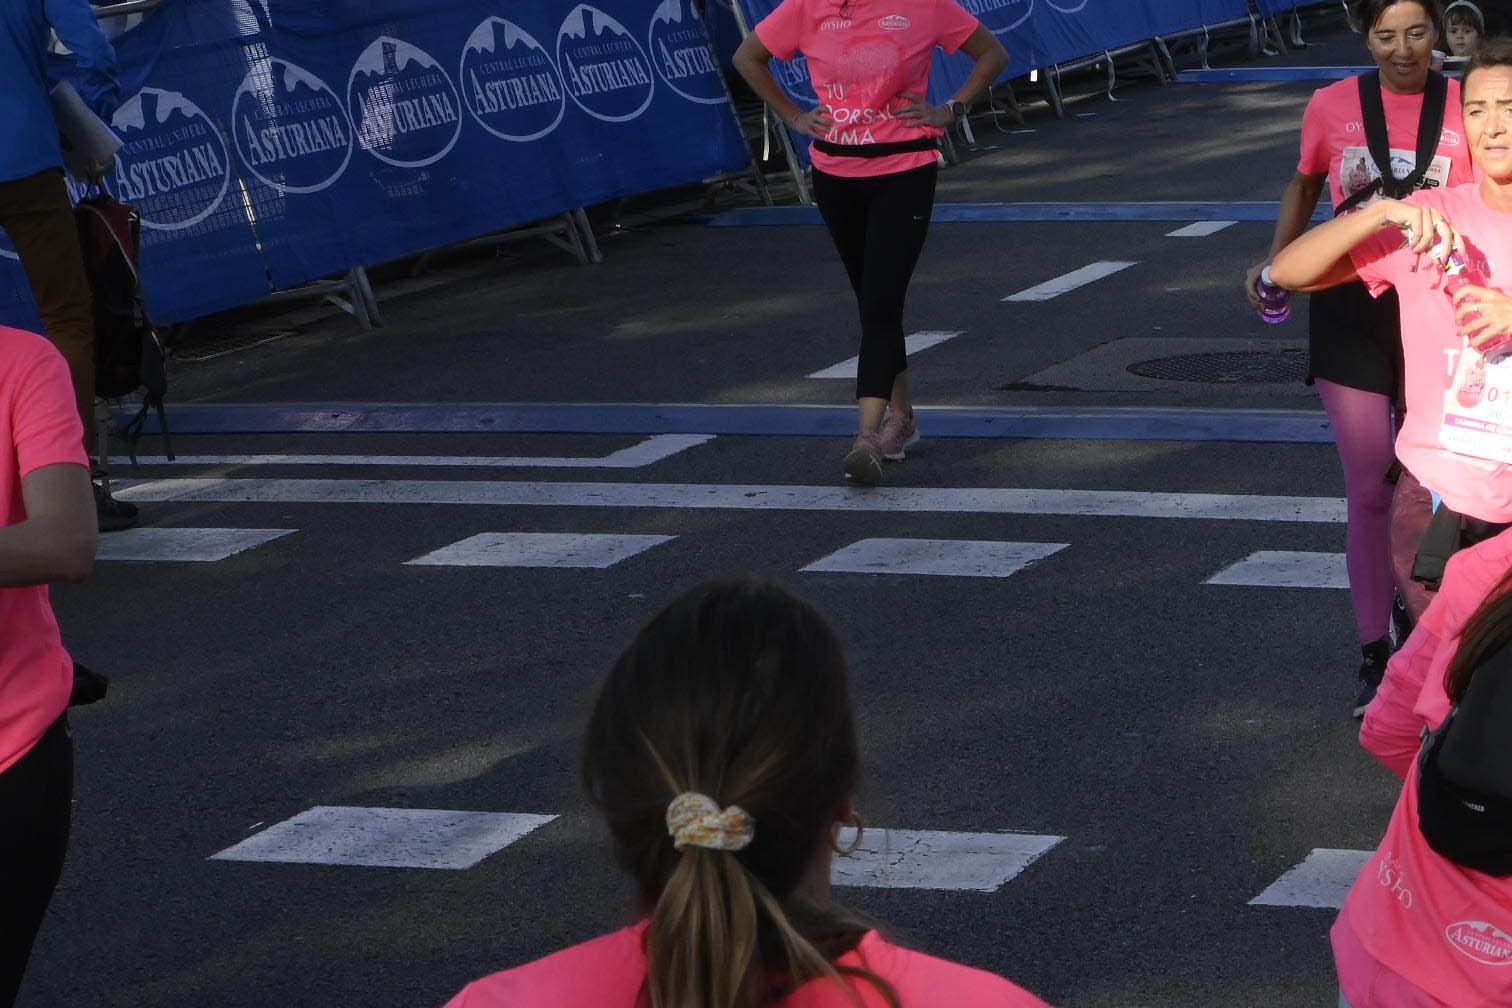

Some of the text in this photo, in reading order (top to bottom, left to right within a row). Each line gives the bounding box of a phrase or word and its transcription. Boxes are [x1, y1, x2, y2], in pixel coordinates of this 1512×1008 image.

[820, 19, 852, 31] OYSHO
[564, 50, 650, 98] ASTURIANA
[657, 37, 718, 80] ASTUR
[468, 67, 562, 116] ASTURIANA
[823, 81, 845, 101] TU
[243, 113, 349, 167] ASTURIANA
[824, 127, 877, 146] UMA
[1443, 348, 1460, 377] T
